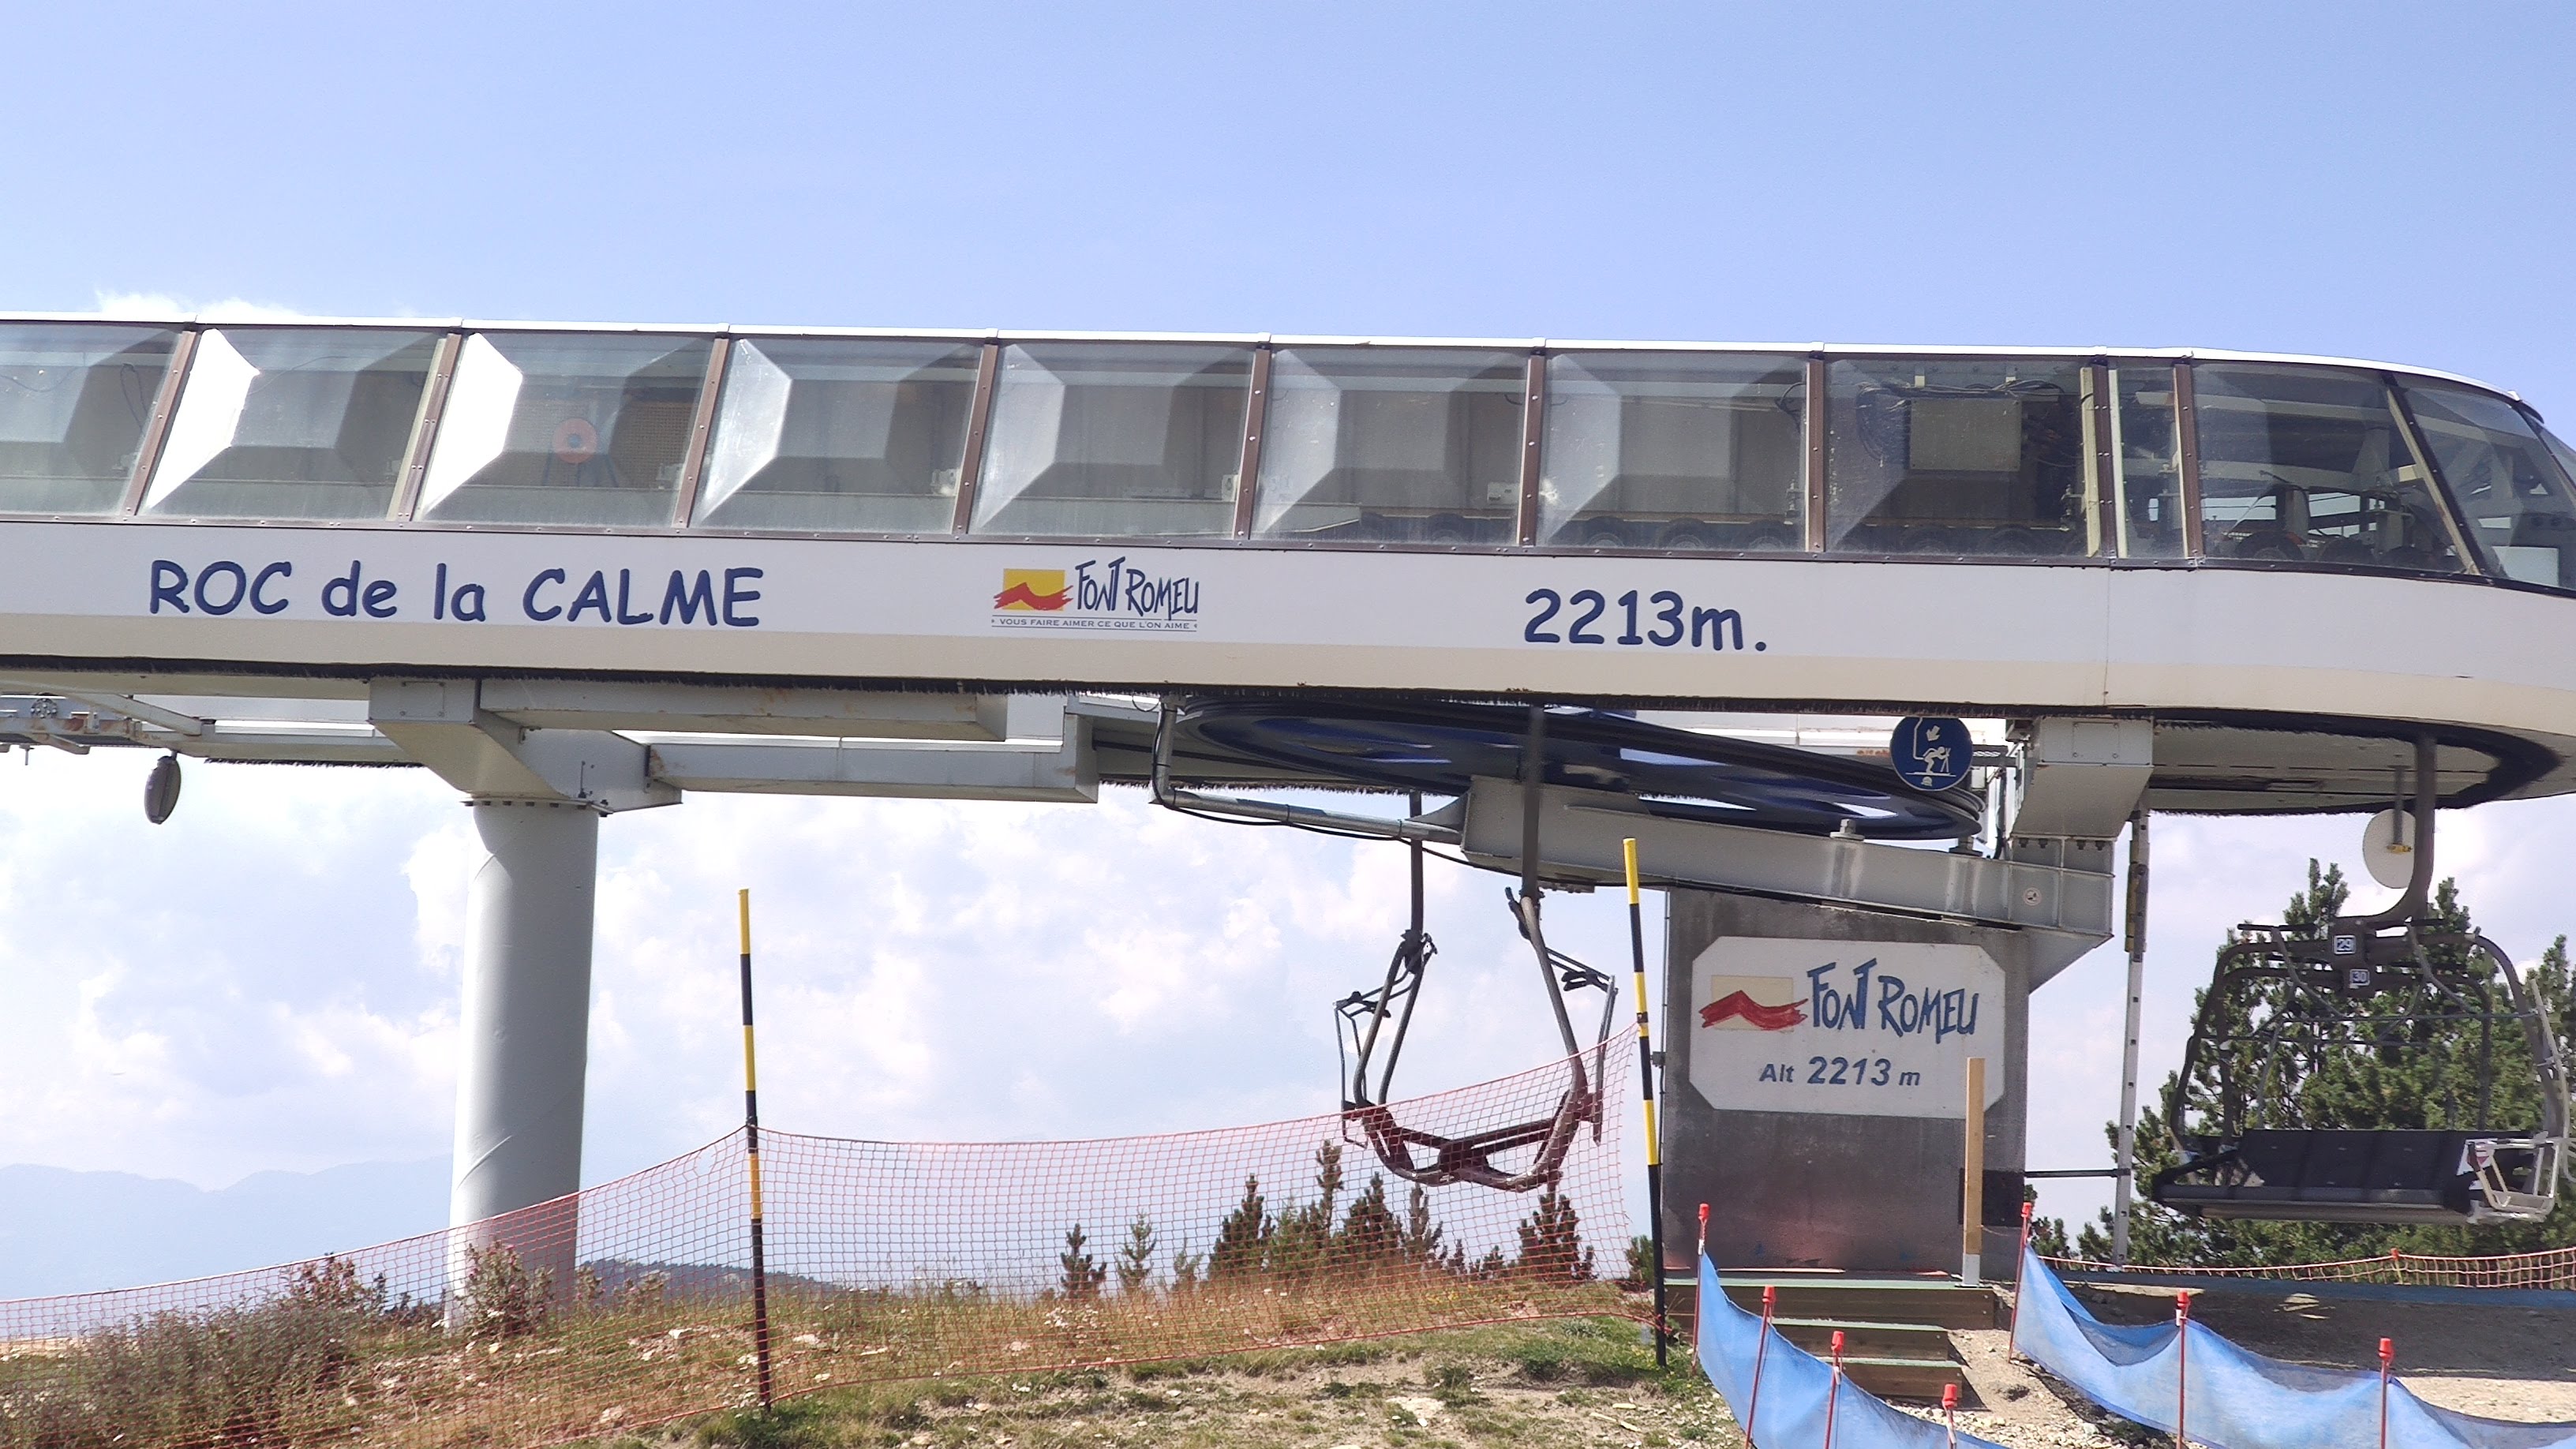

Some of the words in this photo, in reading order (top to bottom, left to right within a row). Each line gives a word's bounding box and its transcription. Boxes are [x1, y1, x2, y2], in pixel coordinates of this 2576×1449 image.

[149, 560, 293, 616] ROC
[320, 560, 398, 618] de
[433, 562, 487, 622] la
[522, 567, 764, 627] CALME
[1075, 556, 1126, 611] FONT
[1125, 568, 1200, 621] ROMEU
[1524, 588, 1767, 652] 2213m.
[2337, 938, 2351, 951] 29
[1807, 957, 1878, 1030] FONT
[1877, 975, 1979, 1044] ROMEU
[2352, 971, 2367, 983] 30
[1759, 1063, 1795, 1084] Alt
[1807, 1056, 1892, 1087] 2213
[1899, 1071, 1921, 1086] m
